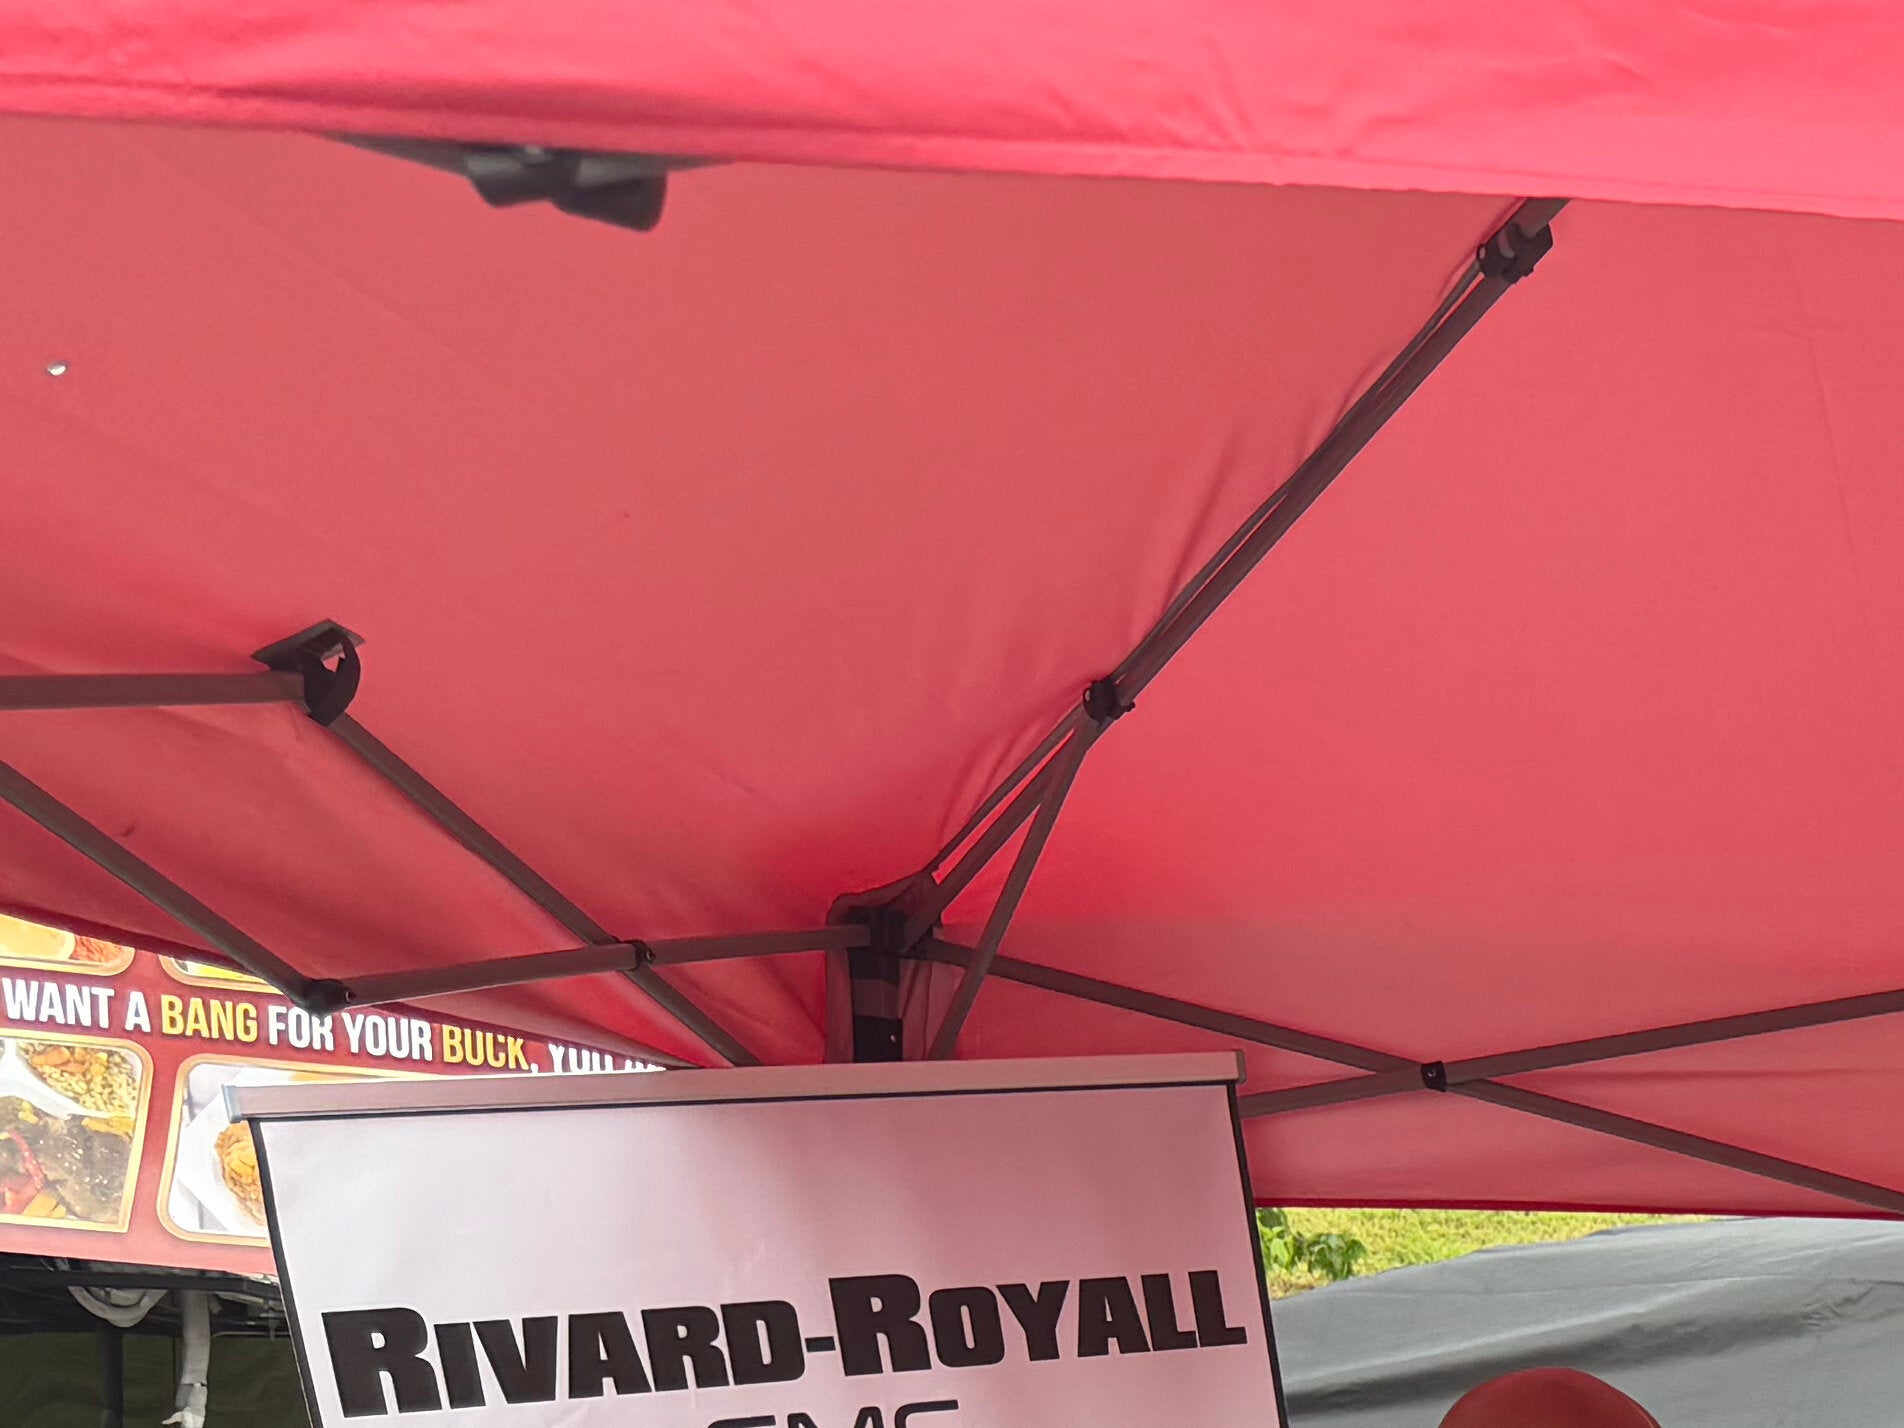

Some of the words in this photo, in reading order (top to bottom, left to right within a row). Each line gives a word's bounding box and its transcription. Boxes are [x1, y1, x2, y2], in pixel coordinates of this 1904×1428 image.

[2, 977, 115, 1029] WANT
[124, 991, 151, 1033] A
[160, 994, 258, 1043] BANG
[268, 1004, 335, 1051] FOR
[341, 1011, 433, 1062] YOUR
[321, 1269, 1249, 1419] RIVARD-ROYALL
